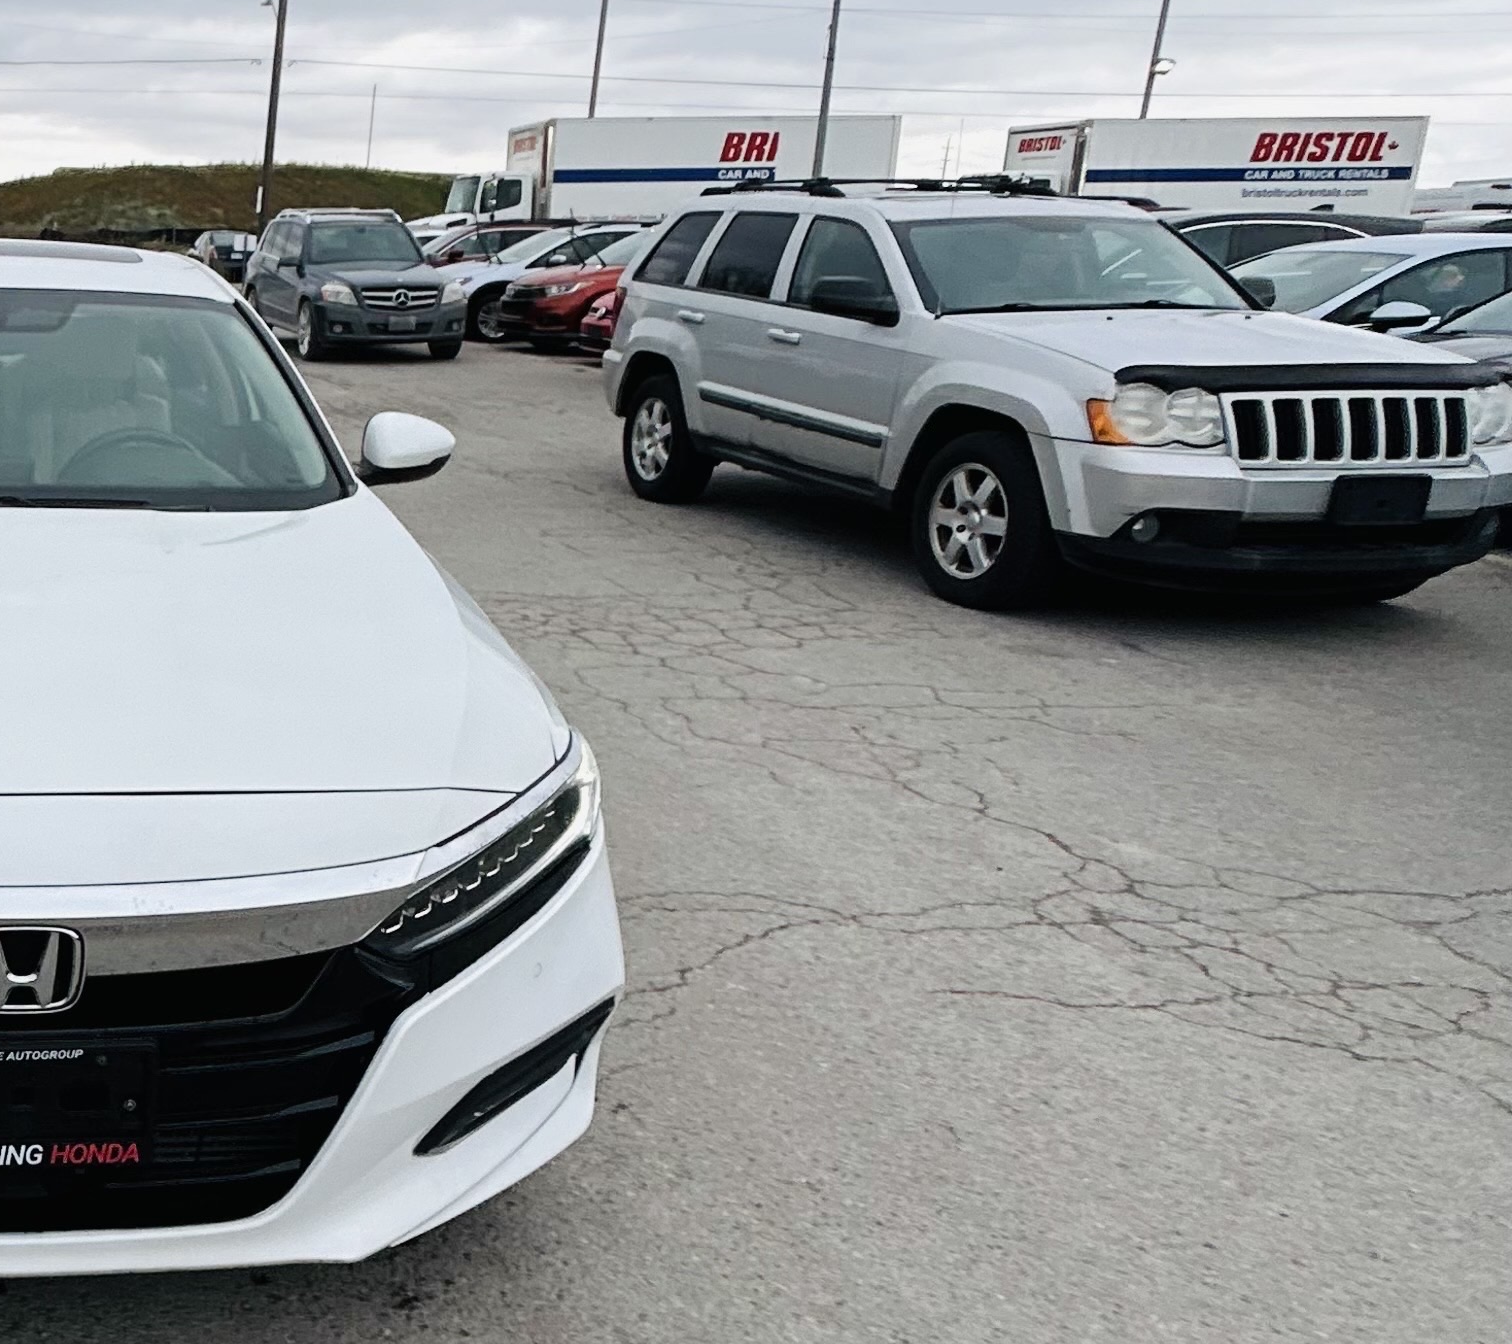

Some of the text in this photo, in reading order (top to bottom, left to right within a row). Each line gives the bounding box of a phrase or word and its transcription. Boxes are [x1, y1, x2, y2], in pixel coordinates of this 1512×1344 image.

[1018, 136, 1062, 153] BRISTOL
[1249, 131, 1388, 162] BRISTOL
[718, 169, 770, 180] CAR AND
[1244, 168, 1389, 180] CAR AND TRUCK RENTALS
[1241, 187, 1368, 198] bristoltruckrentals.com
[6, 1048, 84, 1062] AUTOGROUP
[50, 1143, 139, 1165] HONDA
